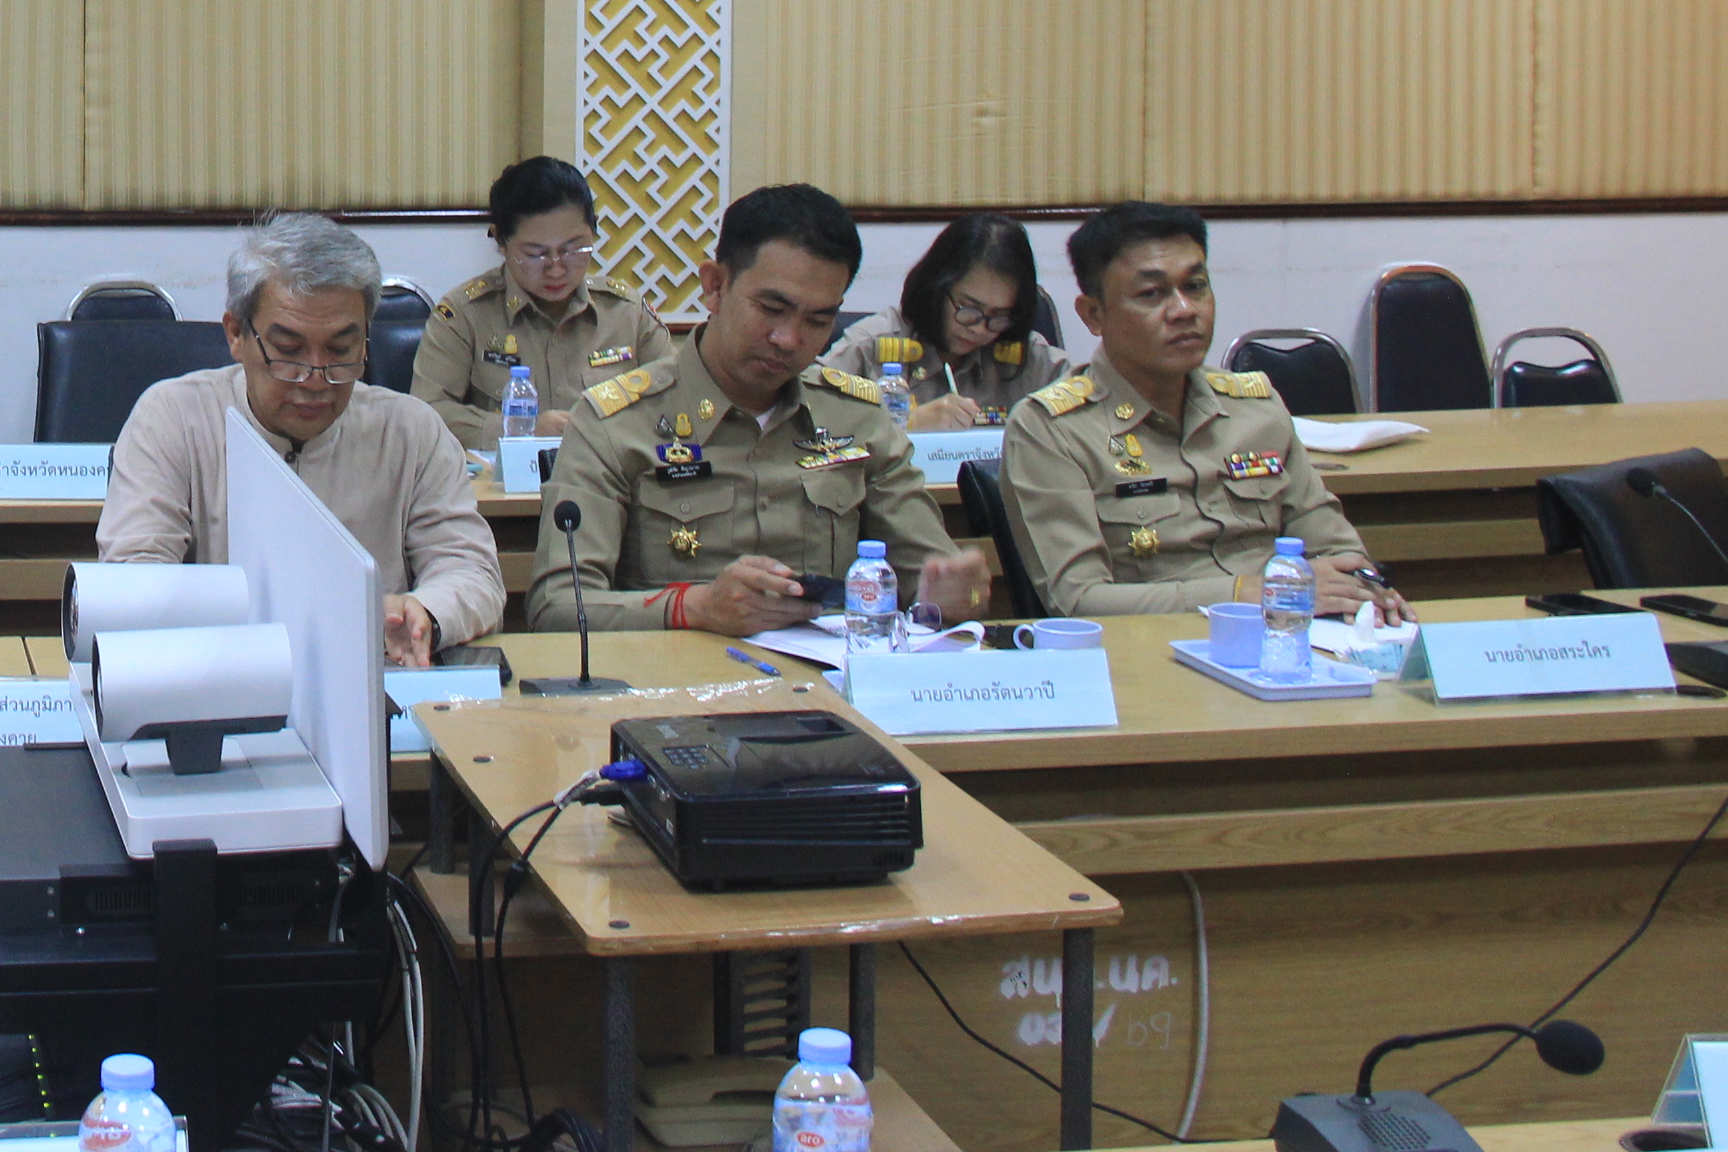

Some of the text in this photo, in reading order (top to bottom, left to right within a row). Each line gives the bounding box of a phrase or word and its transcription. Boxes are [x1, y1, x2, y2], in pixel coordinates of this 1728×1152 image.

[927, 446, 1002, 461] เสมียนตราจังหวั
[1484, 639, 1611, 663] นายอำเภอสระใคร
[910, 679, 1056, 702] นายอำเภอรัตนวาปี
